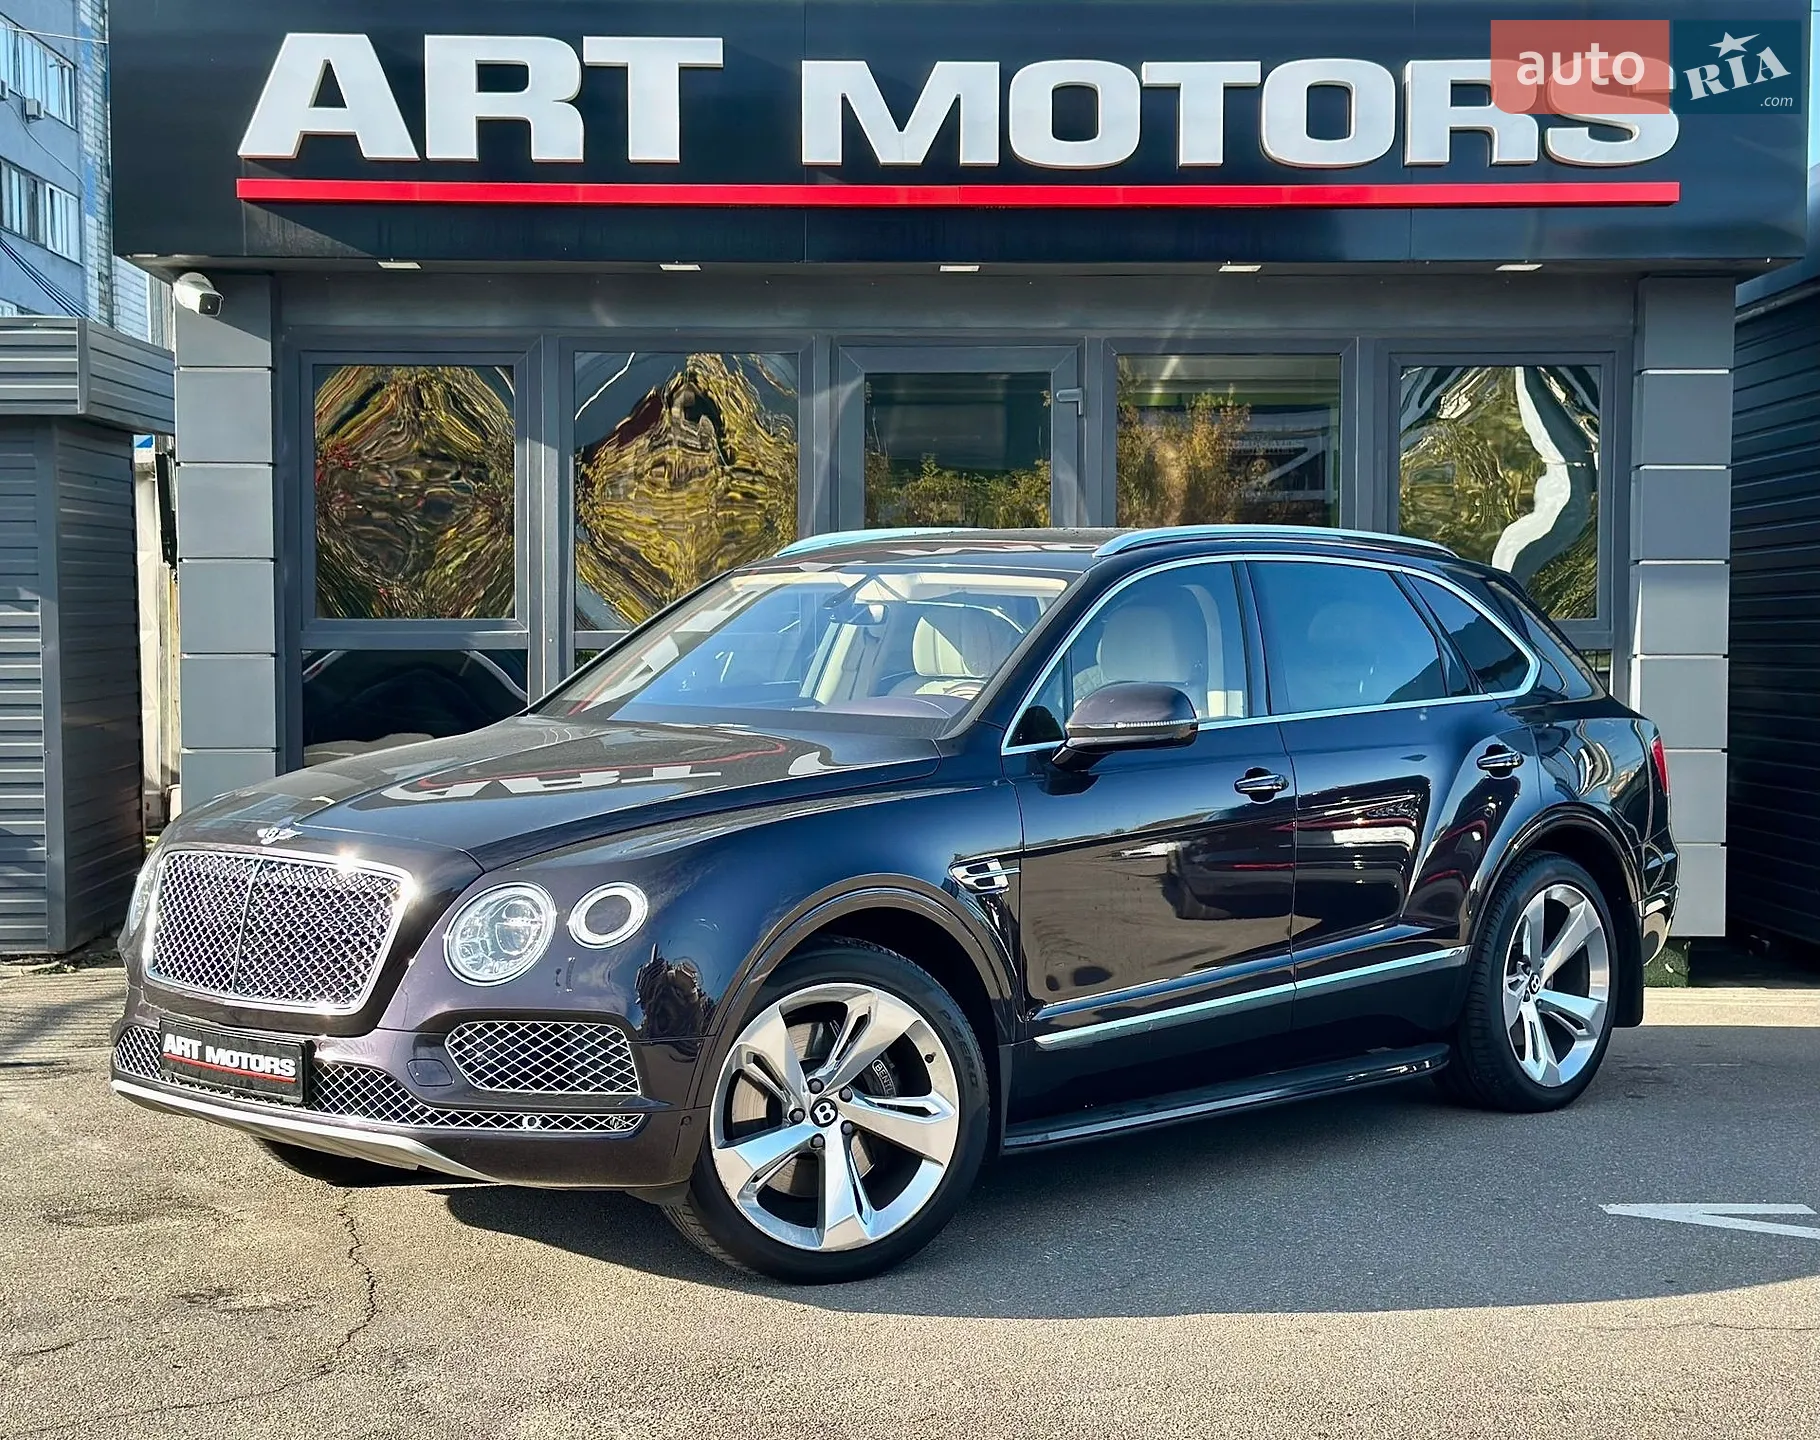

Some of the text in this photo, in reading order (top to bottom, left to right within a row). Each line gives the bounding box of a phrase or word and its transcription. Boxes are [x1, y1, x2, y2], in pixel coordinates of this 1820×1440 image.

[237, 32, 1680, 168] ART MOTORS
[162, 1033, 296, 1077] ART MOTORS
[874, 1063, 894, 1096] BENTL
[813, 1102, 836, 1124] B
